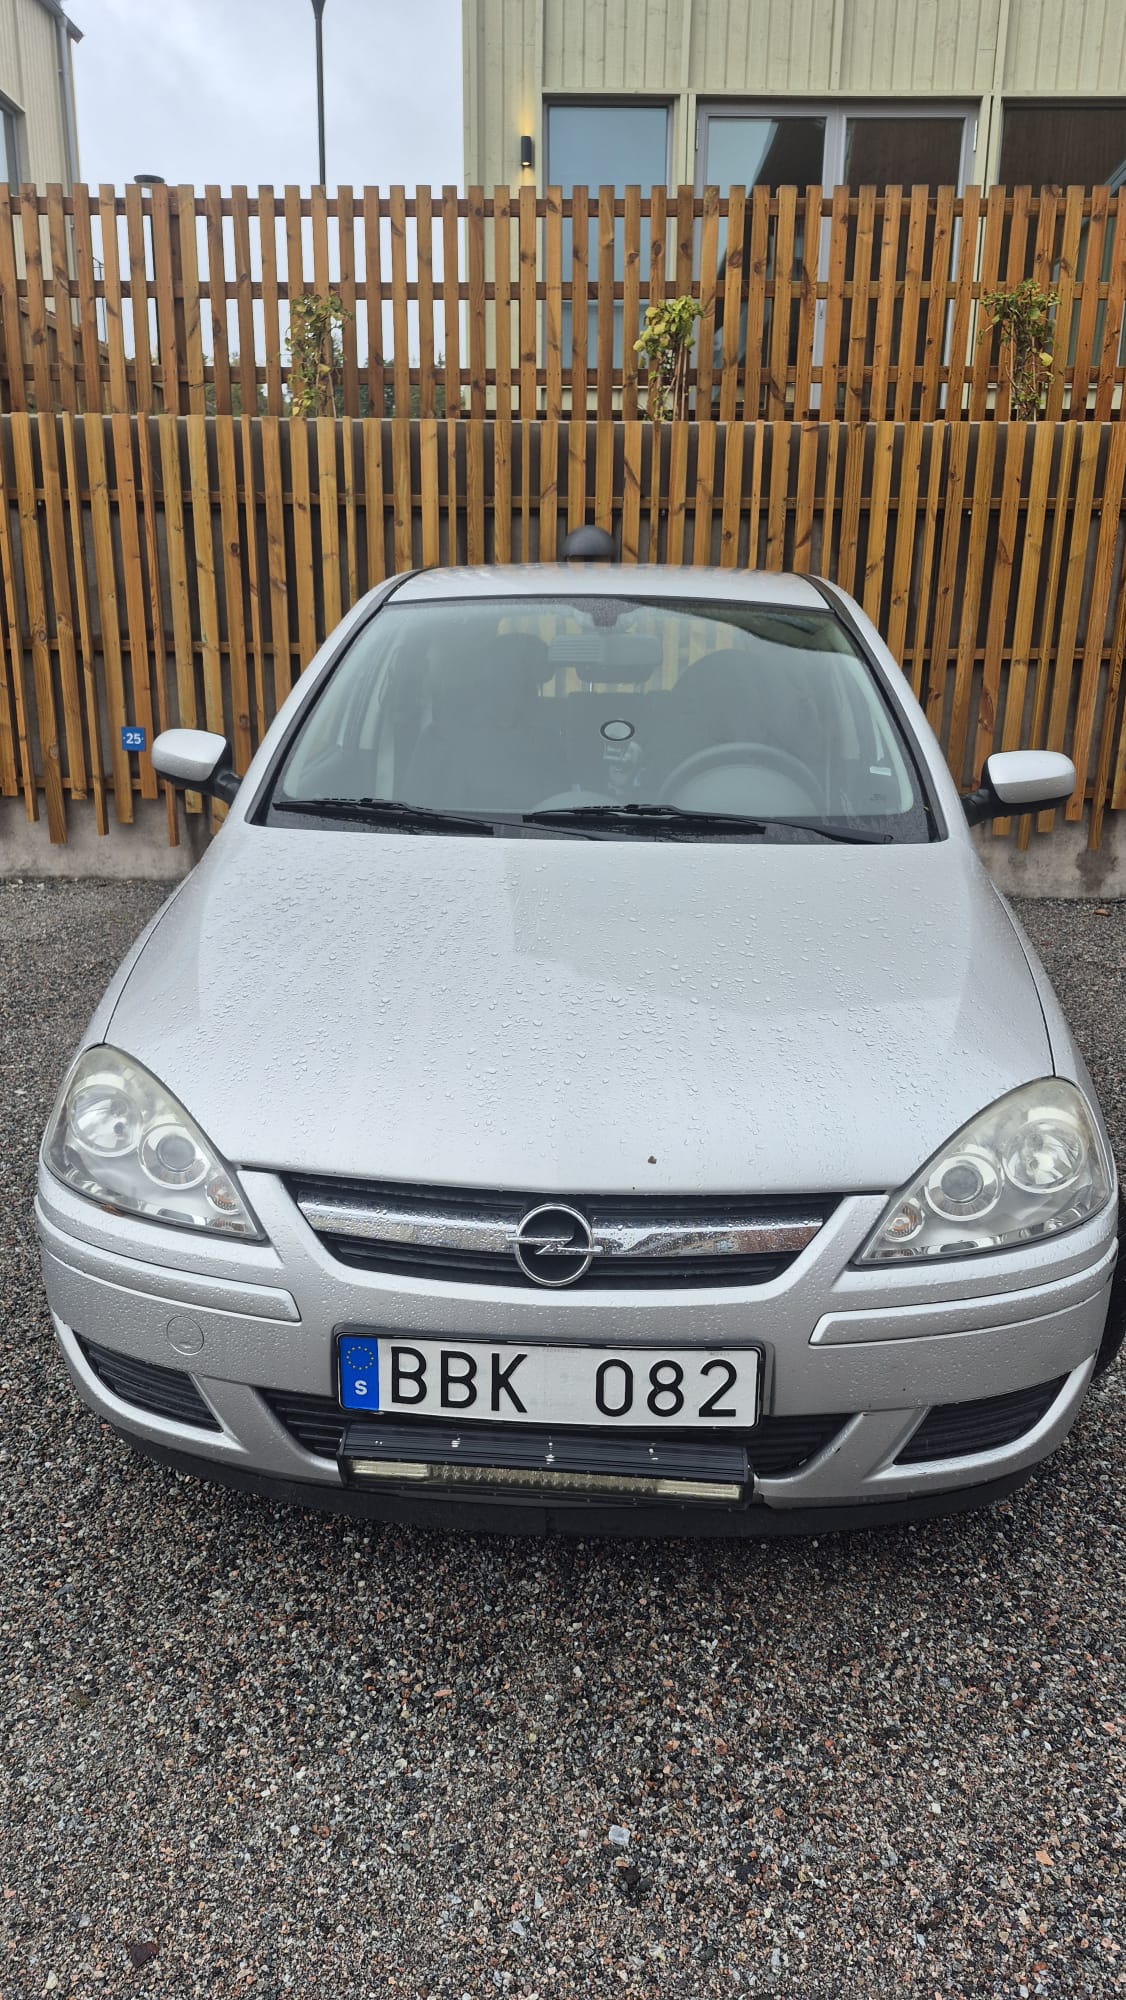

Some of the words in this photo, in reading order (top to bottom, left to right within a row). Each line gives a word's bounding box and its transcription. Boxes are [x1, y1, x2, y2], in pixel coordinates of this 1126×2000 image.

[126, 732, 142, 745] 25
[354, 1379, 368, 1396] S
[390, 1345, 528, 1414] BBK
[595, 1358, 737, 1418] 082
